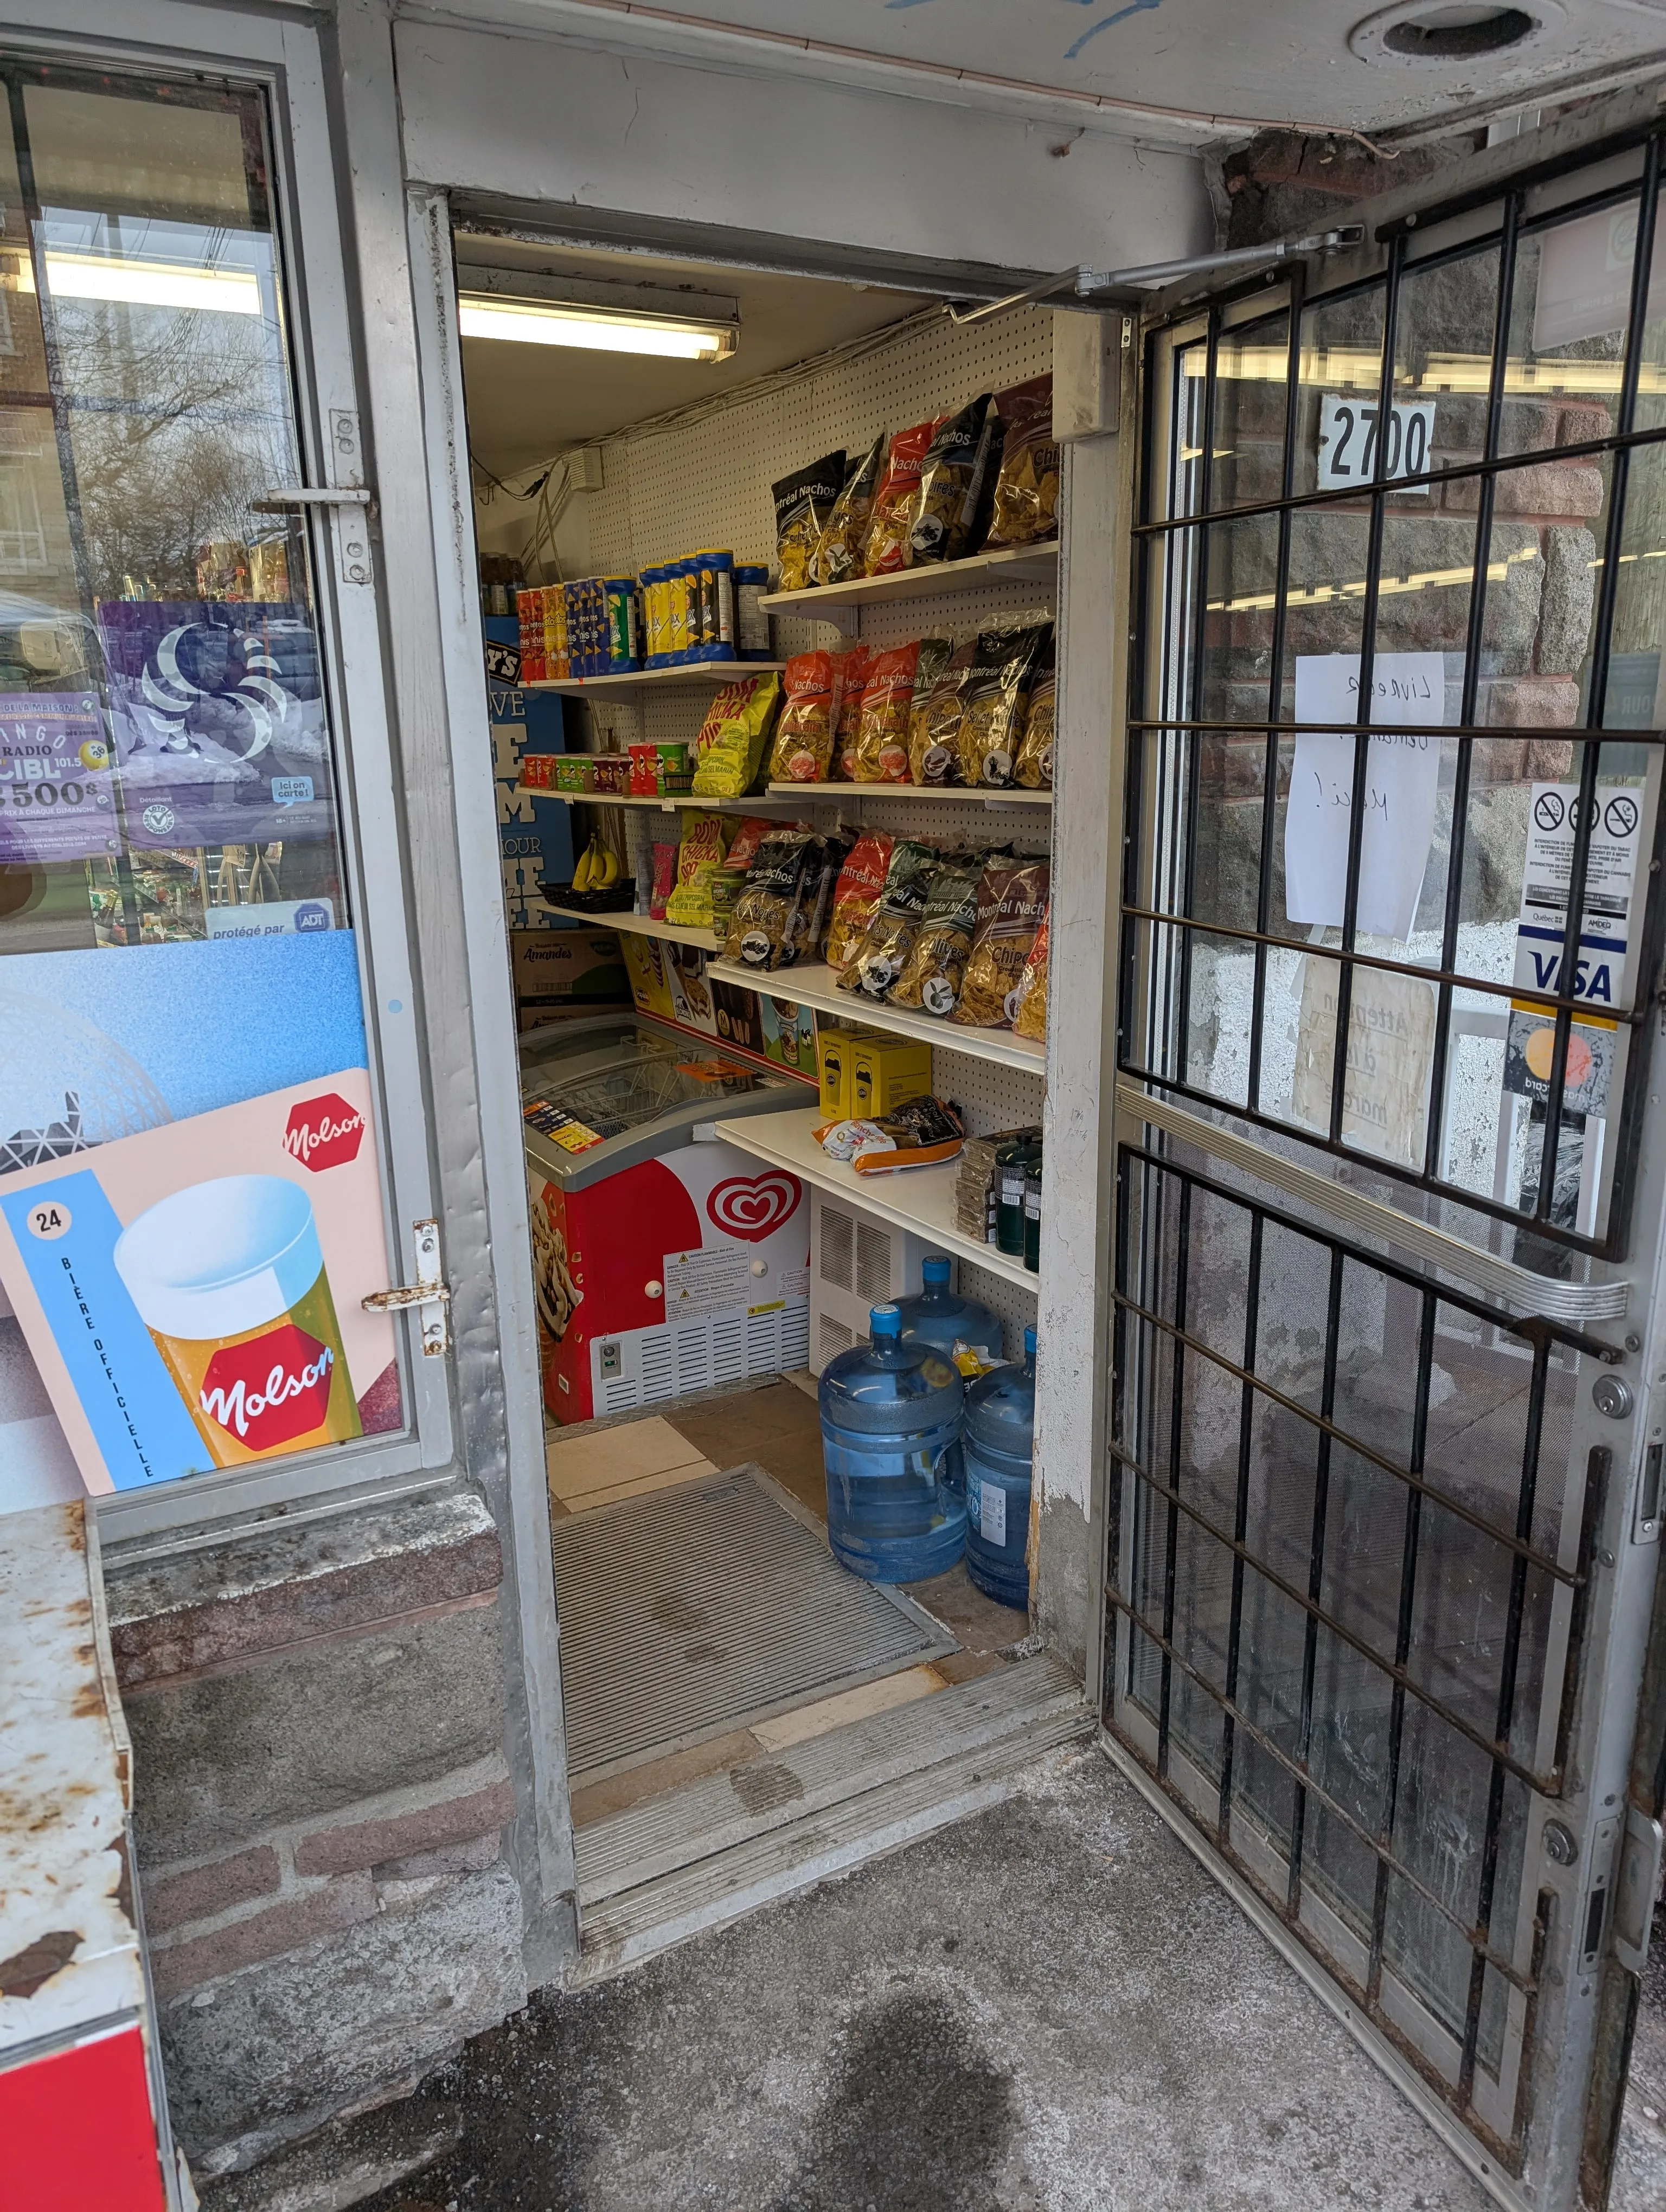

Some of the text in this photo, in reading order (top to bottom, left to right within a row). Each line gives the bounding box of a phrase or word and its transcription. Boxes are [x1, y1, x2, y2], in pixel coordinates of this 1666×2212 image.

[799, 483, 836, 498] Nachos
[793, 678, 824, 693] Nachos
[880, 674, 914, 687] Nachos
[3, 745, 52, 757] RADIO
[92, 745, 106, 759] 36
[54, 757, 82, 768] 101.5
[279, 781, 292, 789] Ici
[148, 805, 166, 813] LOTO
[682, 845, 719, 863] CHICKA
[1539, 887, 1562, 895] CONCERNANT
[1015, 901, 1045, 916] Nach
[301, 915, 324, 926] ADT
[1533, 912, 1554, 923] Québec
[264, 924, 285, 936] par
[523, 947, 572, 963] Amandes
[282, 1113, 367, 1162] Molson
[35, 1208, 62, 1232] 24
[61, 1256, 154, 1478] BIÈRE OFFICIELLE
[199, 1345, 335, 1438] Molson
